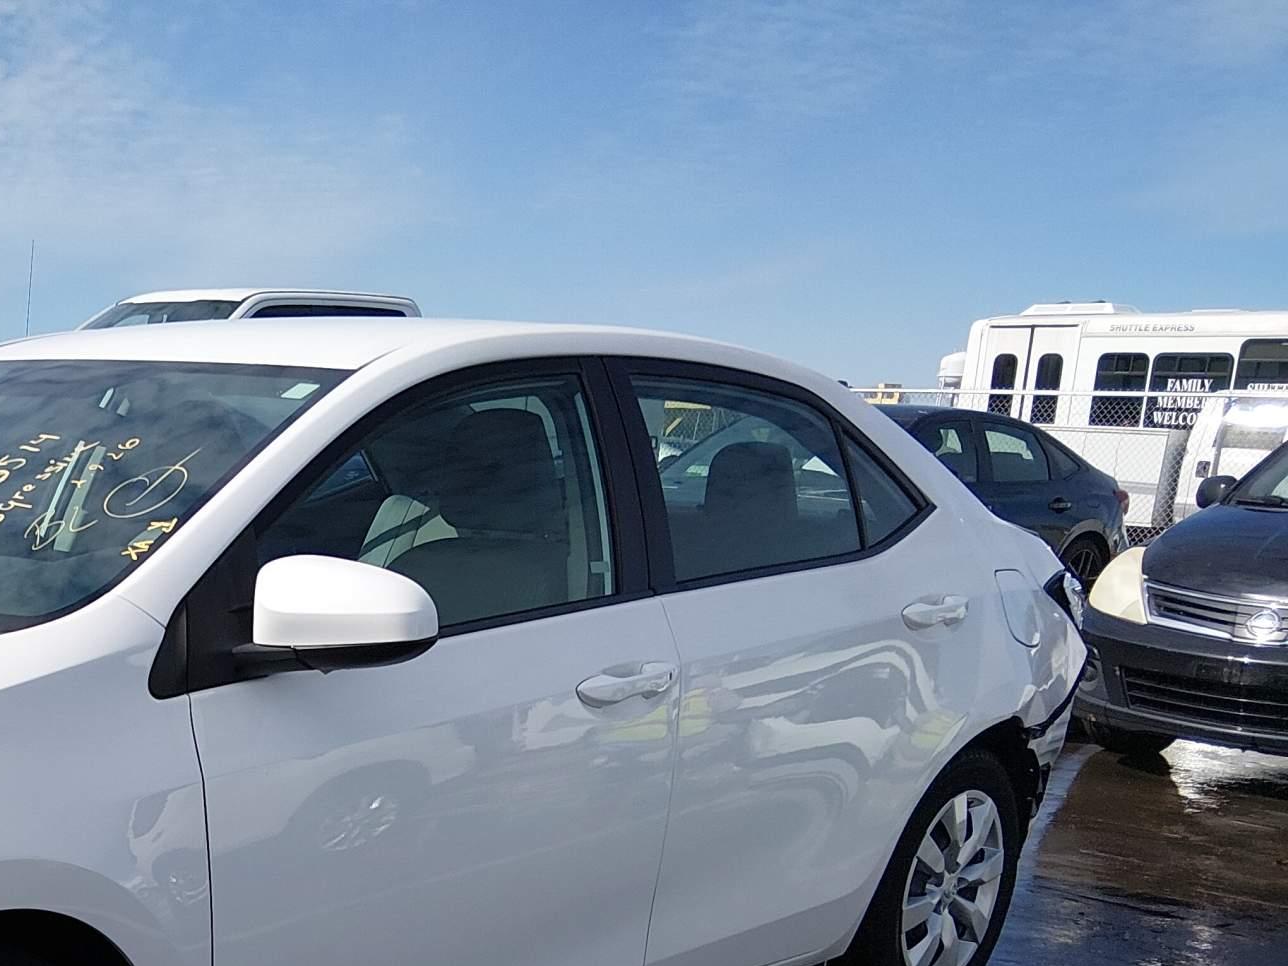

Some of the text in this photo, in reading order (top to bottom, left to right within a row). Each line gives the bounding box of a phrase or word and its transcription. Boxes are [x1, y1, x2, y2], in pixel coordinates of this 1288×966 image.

[1109, 324, 1195, 332] SHUTTLE EXPRESS
[1166, 378, 1214, 392] FAMILY
